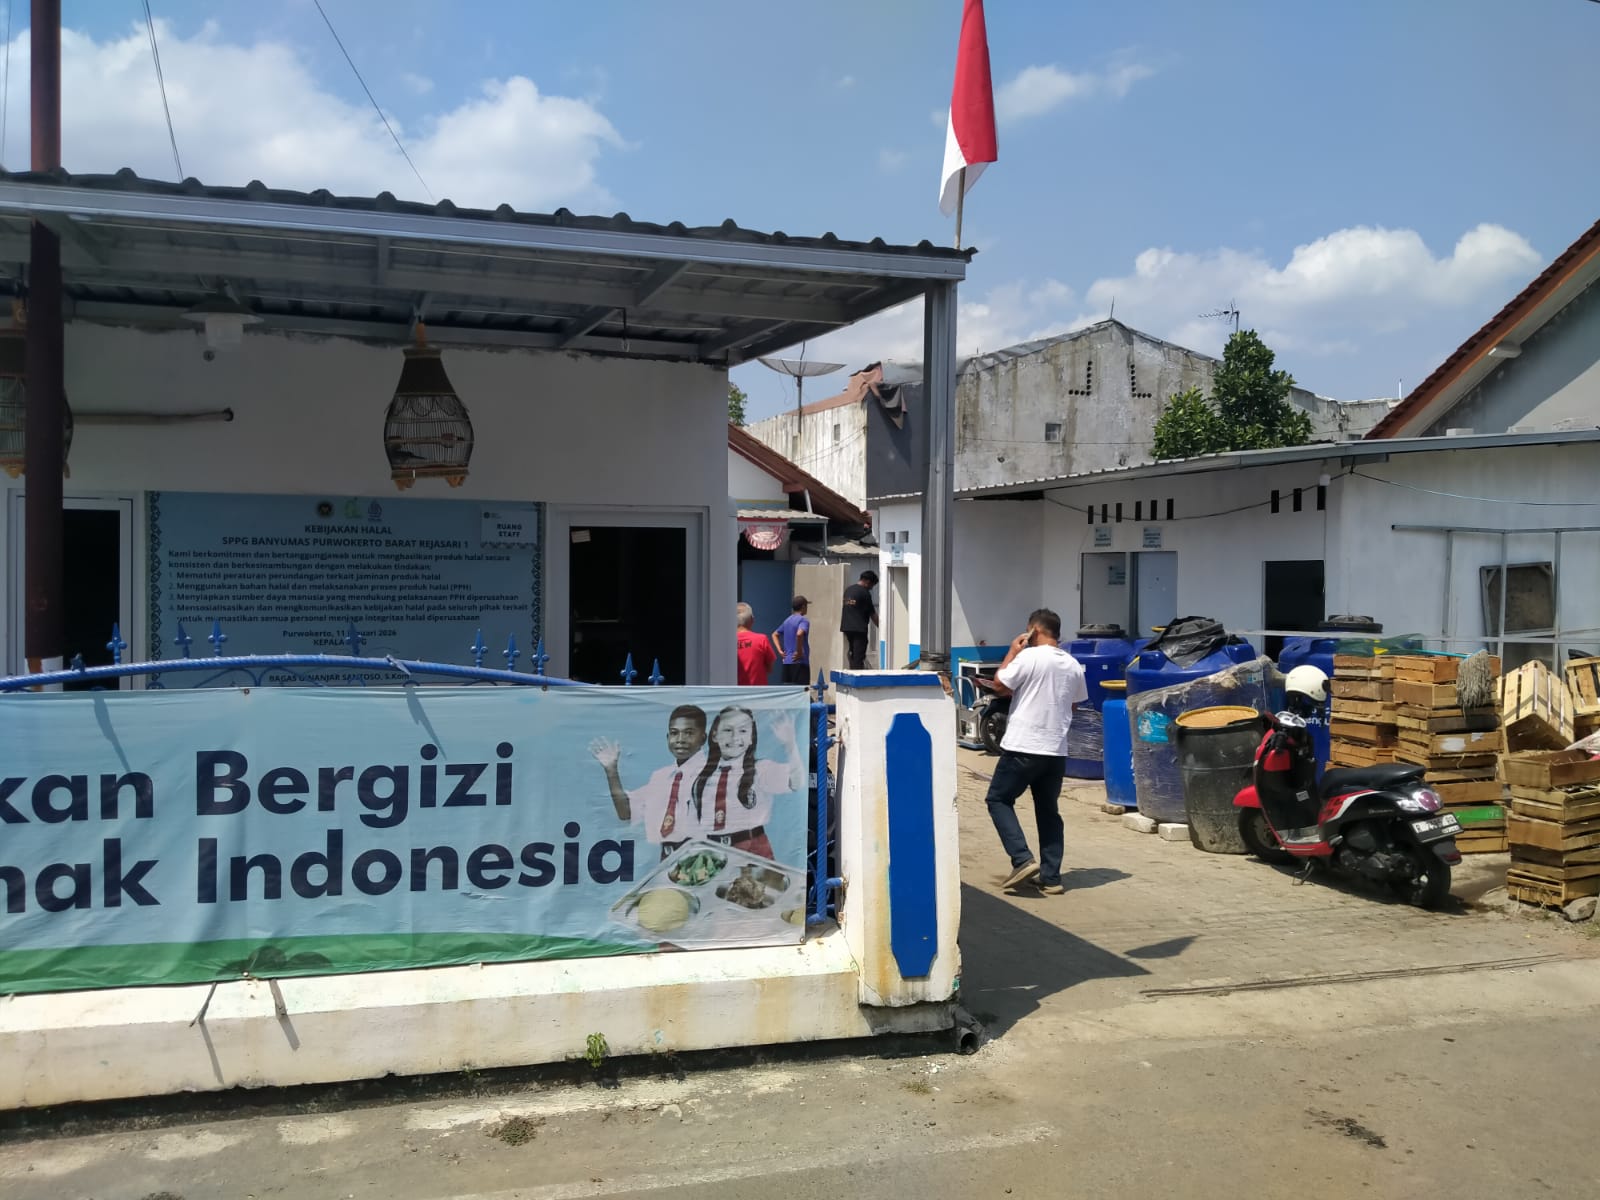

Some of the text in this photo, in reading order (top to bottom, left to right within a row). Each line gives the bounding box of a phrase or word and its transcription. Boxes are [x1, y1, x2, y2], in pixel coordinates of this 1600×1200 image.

[305, 525, 392, 535] KEBIJAKAN HALAL
[497, 523, 522, 531] RUANG
[222, 537, 248, 545] SPPG
[252, 537, 310, 546] BANYUMAS
[313, 538, 382, 547] PURWOKERTO
[385, 540, 416, 548] BARAT
[419, 540, 461, 549] REJASARI
[268, 573, 324, 581] perundangan
[356, 573, 389, 581] jaminan
[177, 583, 237, 591] Menggunakan
[177, 594, 229, 602] Menyiapkan
[266, 594, 286, 602] daya
[364, 604, 403, 612] kebijakan
[290, 615, 326, 623] personel
[196, 742, 513, 828] Bergizi
[197, 821, 634, 904] Indonesia
